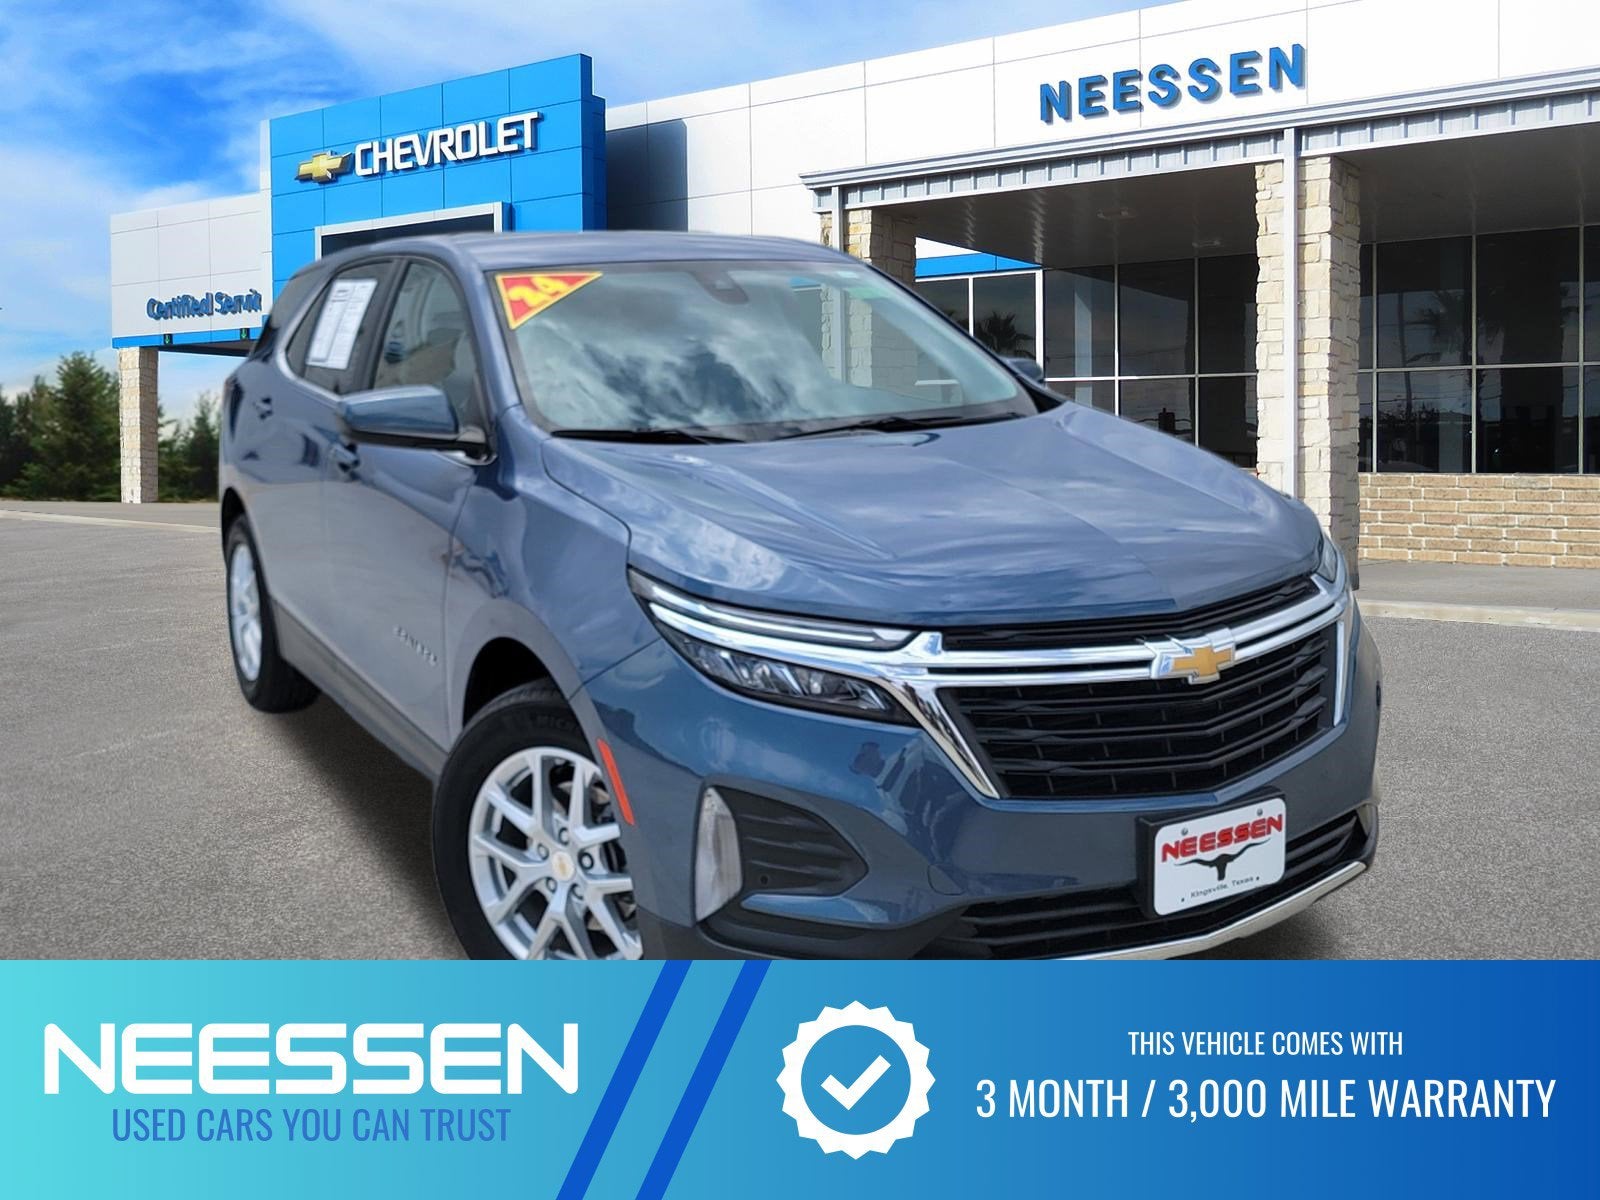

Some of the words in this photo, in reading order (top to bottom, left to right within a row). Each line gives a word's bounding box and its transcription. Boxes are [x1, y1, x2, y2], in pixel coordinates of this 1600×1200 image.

[1040, 43, 1307, 125] NEESSEN
[354, 111, 543, 177] CHEVROLET
[147, 292, 214, 320] Certified
[1161, 813, 1283, 863] NEESSEN
[1232, 875, 1254, 887] Texas
